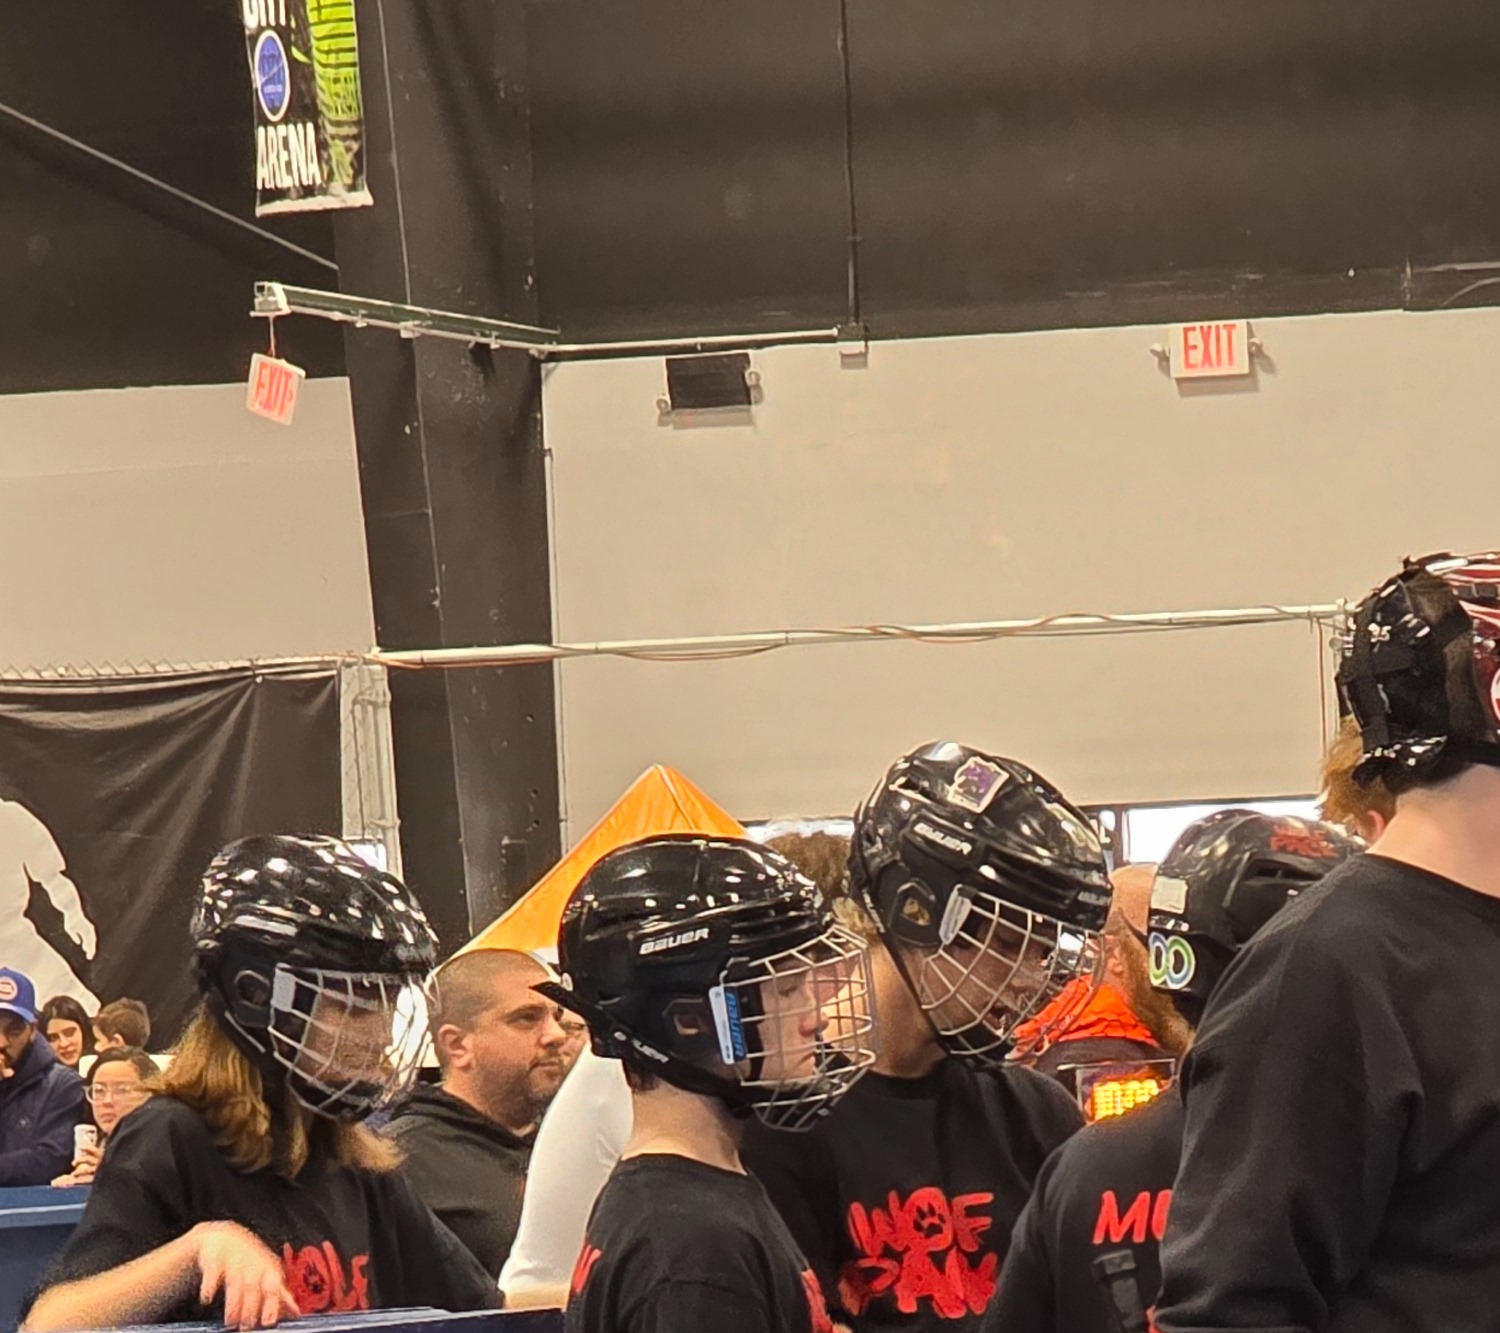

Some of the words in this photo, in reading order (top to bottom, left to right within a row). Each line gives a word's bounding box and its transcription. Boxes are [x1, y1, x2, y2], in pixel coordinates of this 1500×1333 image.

[256, 122, 322, 190] ARENA
[1182, 323, 1237, 370] EXIT
[254, 361, 294, 417] EXIT
[639, 927, 710, 955] BAUER
[724, 990, 746, 1058] BAUER
